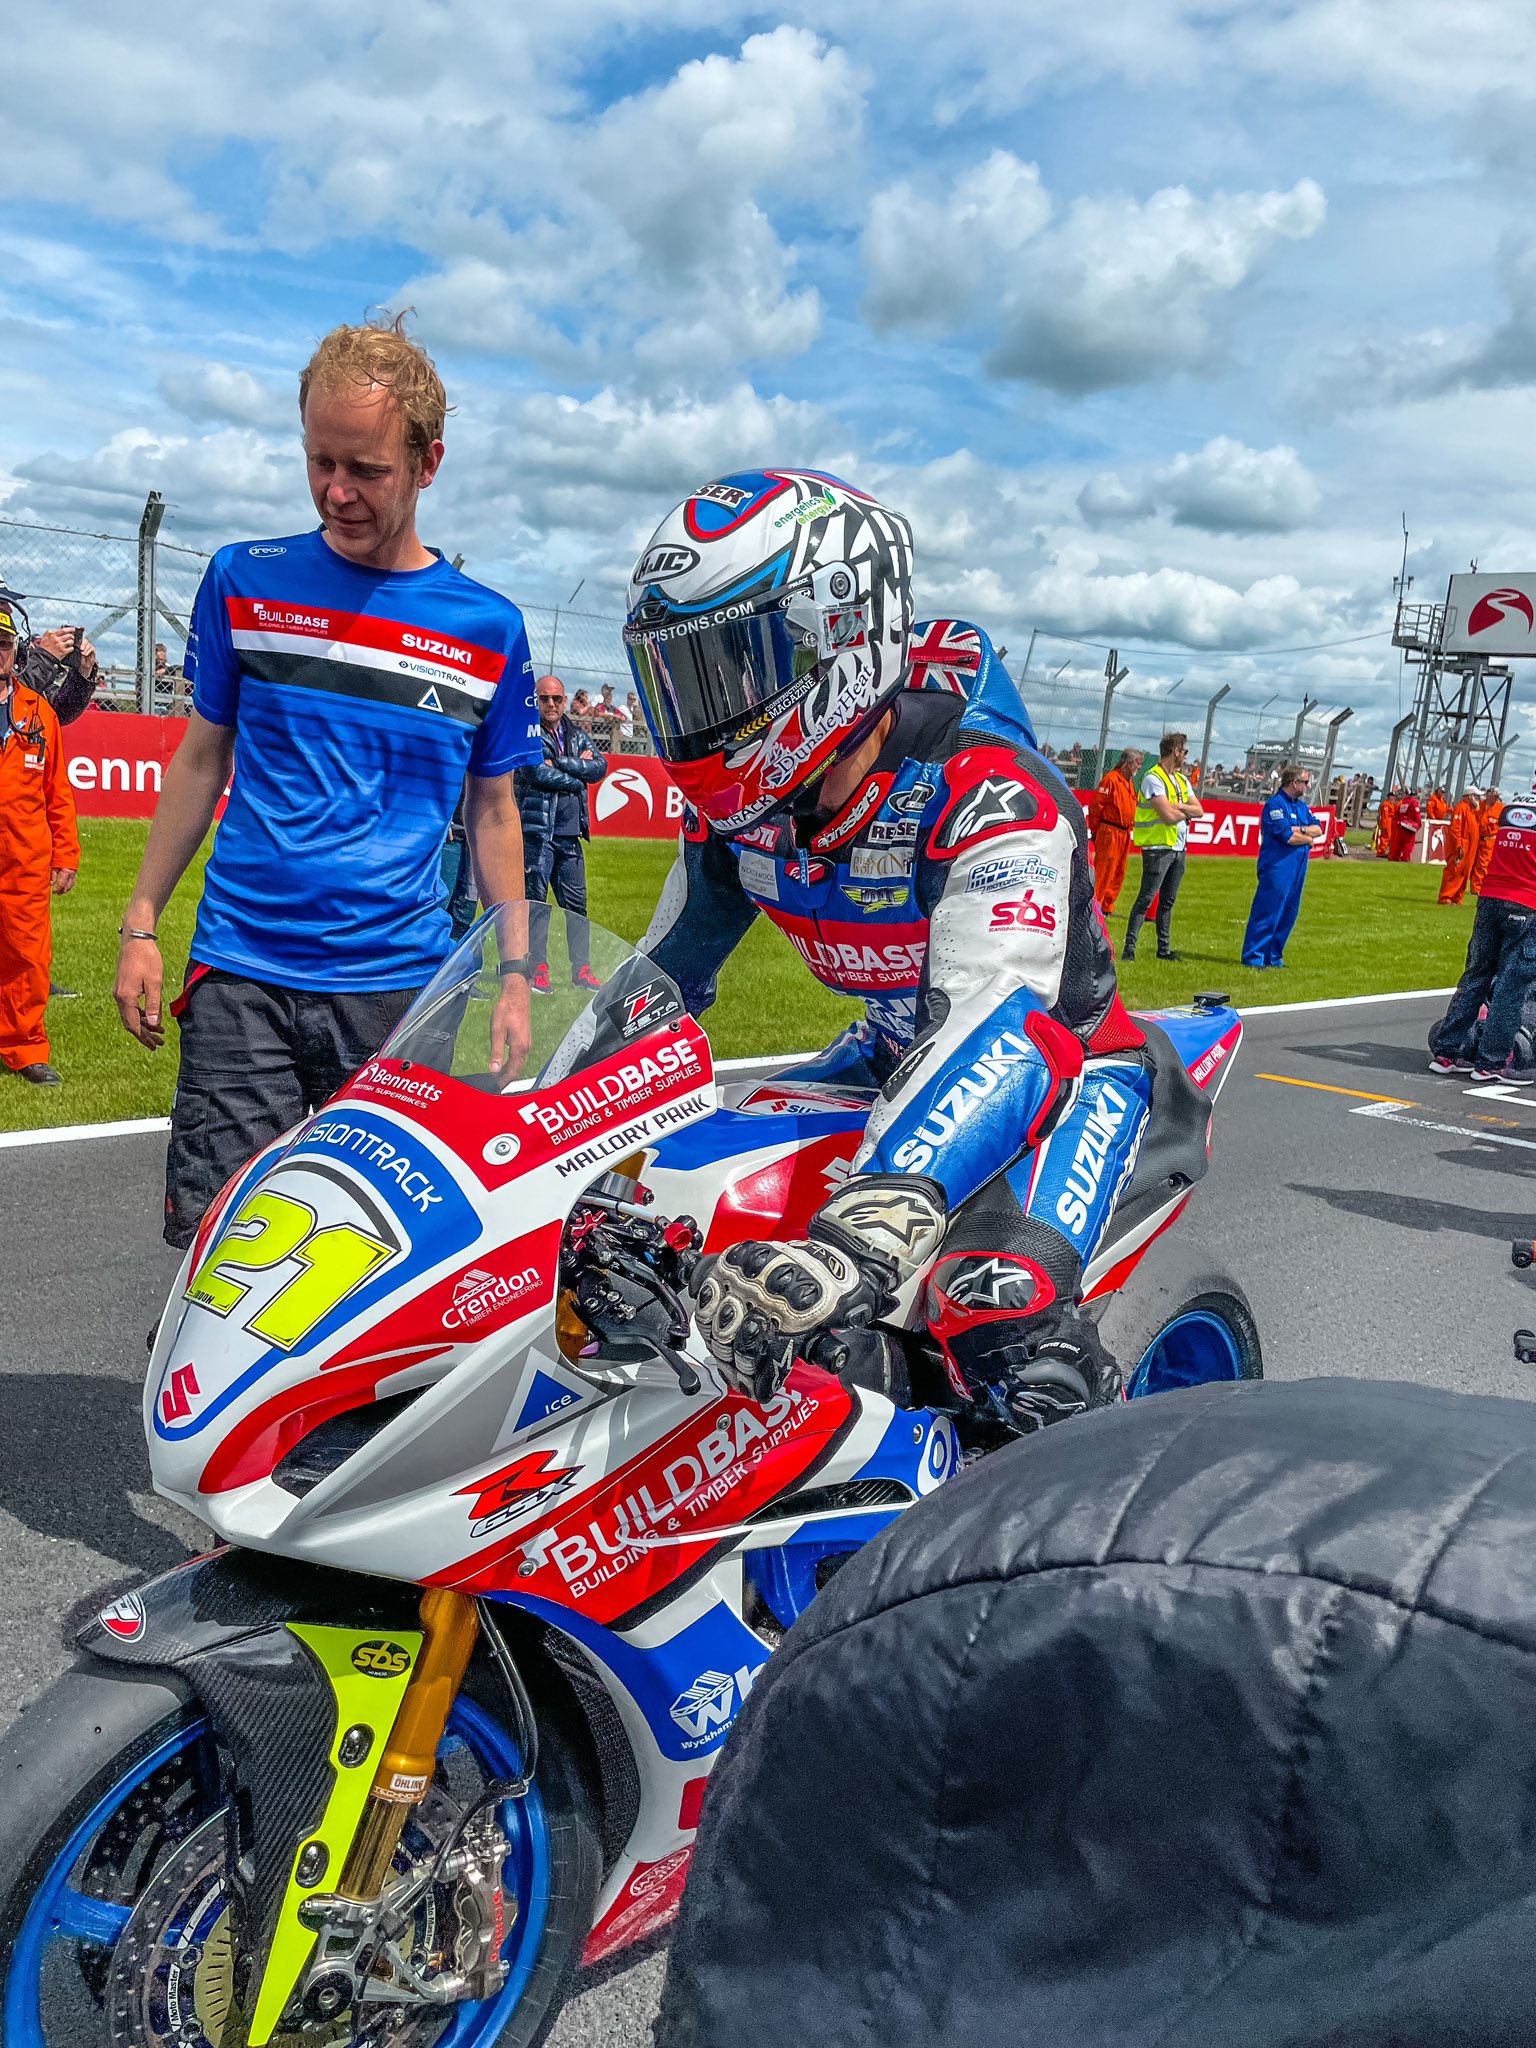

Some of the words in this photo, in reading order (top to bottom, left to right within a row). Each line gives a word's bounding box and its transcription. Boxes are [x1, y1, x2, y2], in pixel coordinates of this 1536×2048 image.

[774, 496, 822, 529] energetics
[798, 505, 830, 525] energy
[258, 610, 330, 629] BUILDBASE
[401, 633, 473, 665] SUZUKI
[409, 662, 467, 687] VISIONTRACK
[765, 680, 801, 712] CONSTRUCTION
[769, 678, 816, 719] MAGAZINE
[972, 857, 1039, 879] POWER
[622, 1001, 679, 1037] ZETA
[374, 1069, 443, 1102] Bennetts
[1191, 1053, 1216, 1084] MALLORY
[374, 1087, 428, 1109] SUPERBIKES
[535, 1038, 698, 1135] BUILDBASE
[892, 1031, 1032, 1174] SUZUKI
[551, 1112, 602, 1146] BUILDING
[604, 1106, 614, 1118] &
[613, 1084, 654, 1112] TIMBER
[655, 1062, 702, 1092] SUPPLIES
[554, 1119, 651, 1178] MALLORY
[652, 1094, 711, 1130] PARK
[296, 1122, 444, 1213] VISIONTRACK
[1056, 1083, 1127, 1236] SUZUKI
[181, 1189, 403, 1355] 21
[441, 1267, 539, 1329] Crendon
[464, 1307, 493, 1328] TIMBER
[493, 1279, 544, 1311] ENGINEERING
[569, 1531, 658, 1599] BUILDING
[666, 1517, 681, 1531] &
[684, 1463, 749, 1519] TIMBER
[752, 1397, 820, 1465] SUPPLIES
[168, 1970, 179, 1999] Master
[169, 2000, 179, 2022] Moto
